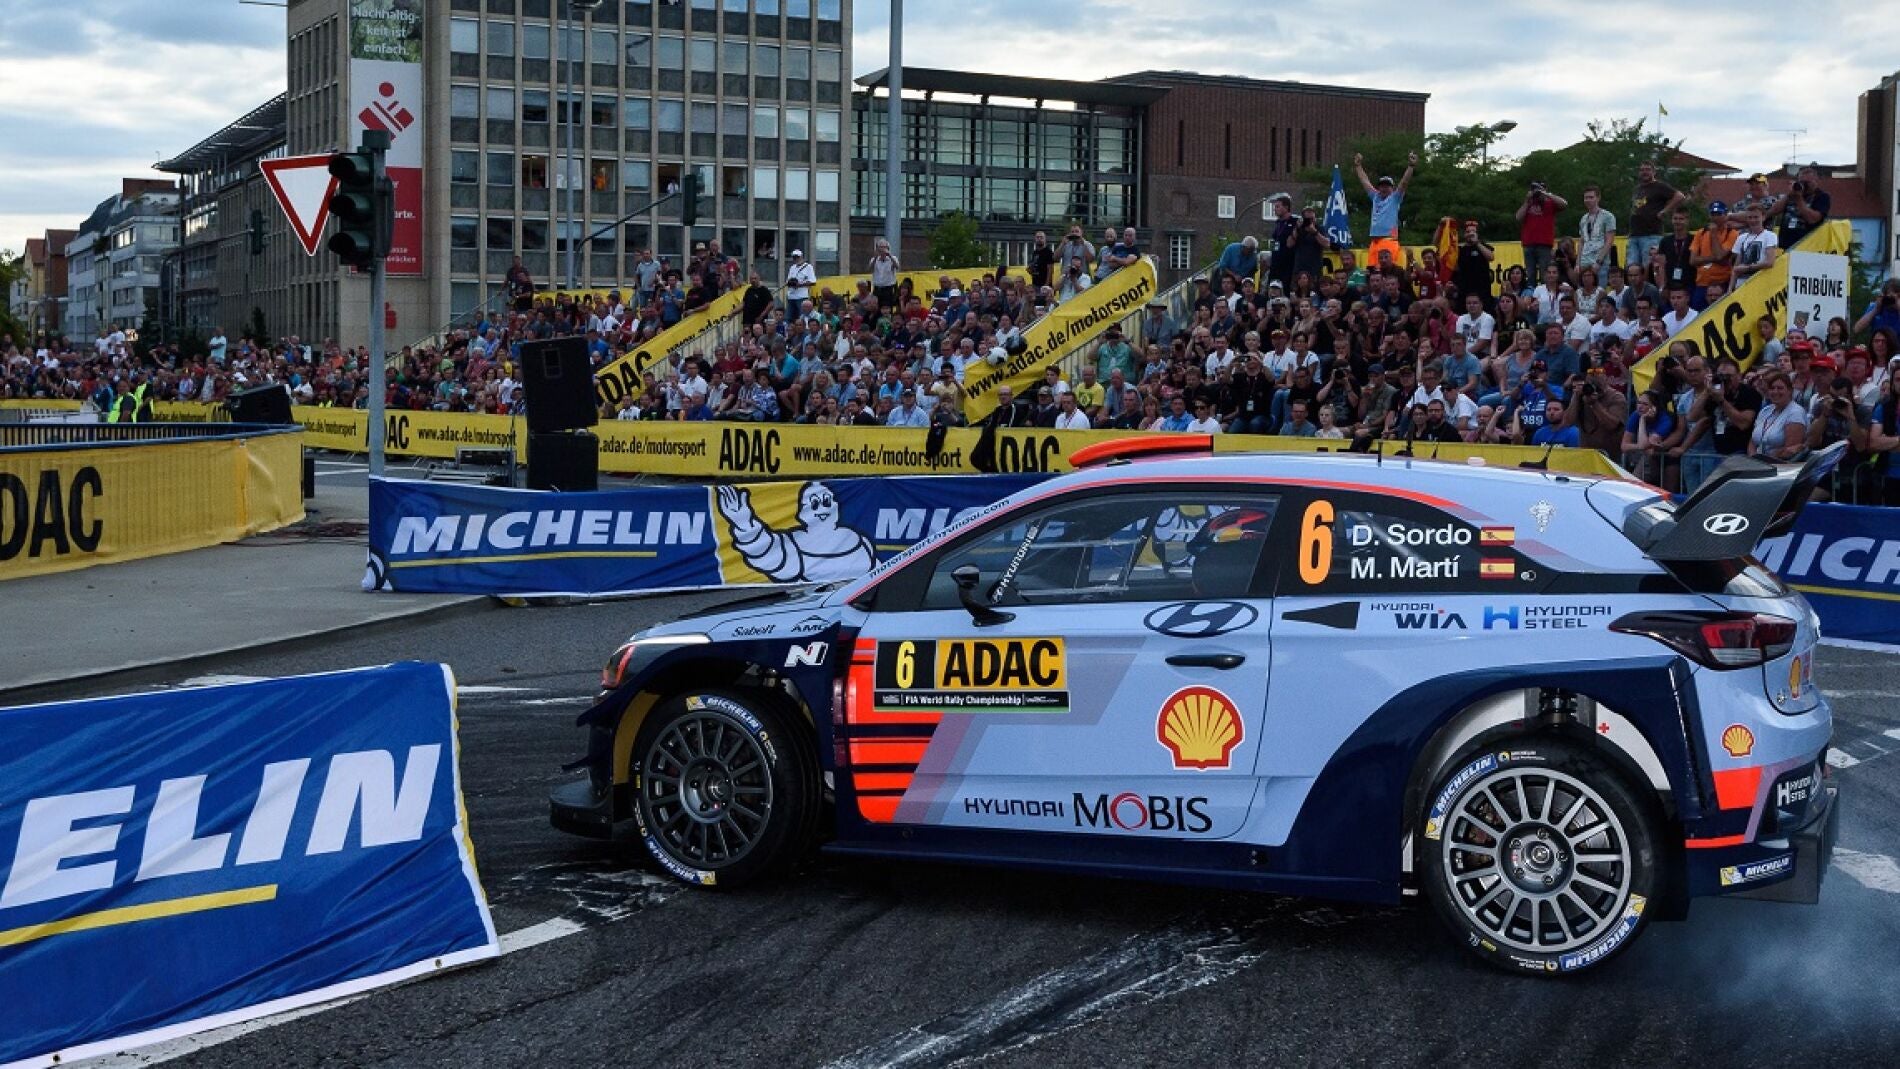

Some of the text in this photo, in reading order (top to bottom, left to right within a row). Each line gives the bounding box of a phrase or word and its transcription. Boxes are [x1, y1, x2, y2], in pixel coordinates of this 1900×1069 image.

[352, 6, 420, 24] Nachhaltig-
[363, 43, 410, 56] einfach.
[1792, 274, 1843, 298] TRIBÜNE
[1812, 304, 1821, 321] 2
[966, 275, 1151, 401] www.adac.de/motorsport
[597, 350, 652, 405] DAC
[719, 428, 780, 474] ADAC
[793, 442, 962, 470] www.adac.de/motorsport
[1001, 435, 1060, 473] DAC
[390, 510, 706, 554] MICHELIN
[1299, 500, 1335, 585] 6
[1352, 523, 1472, 546] D. Sordo
[1350, 554, 1461, 579] M. Martí
[1371, 603, 1434, 611] HYUNDAI
[1525, 606, 1612, 616] HYUNDAI
[1525, 618, 1588, 629] STEEL
[896, 641, 915, 689] 6
[942, 640, 1060, 687] ADAC
[707, 696, 760, 729] MICHELIN
[905, 695, 918, 705] FIA
[920, 695, 943, 705] World
[945, 695, 964, 706] Rally
[966, 695, 1022, 706] Championship
[1437, 756, 1493, 812] MICHELIN
[964, 792, 1213, 833] HYUNDAI MOBIS
[1564, 920, 1632, 970] MICHELIN
